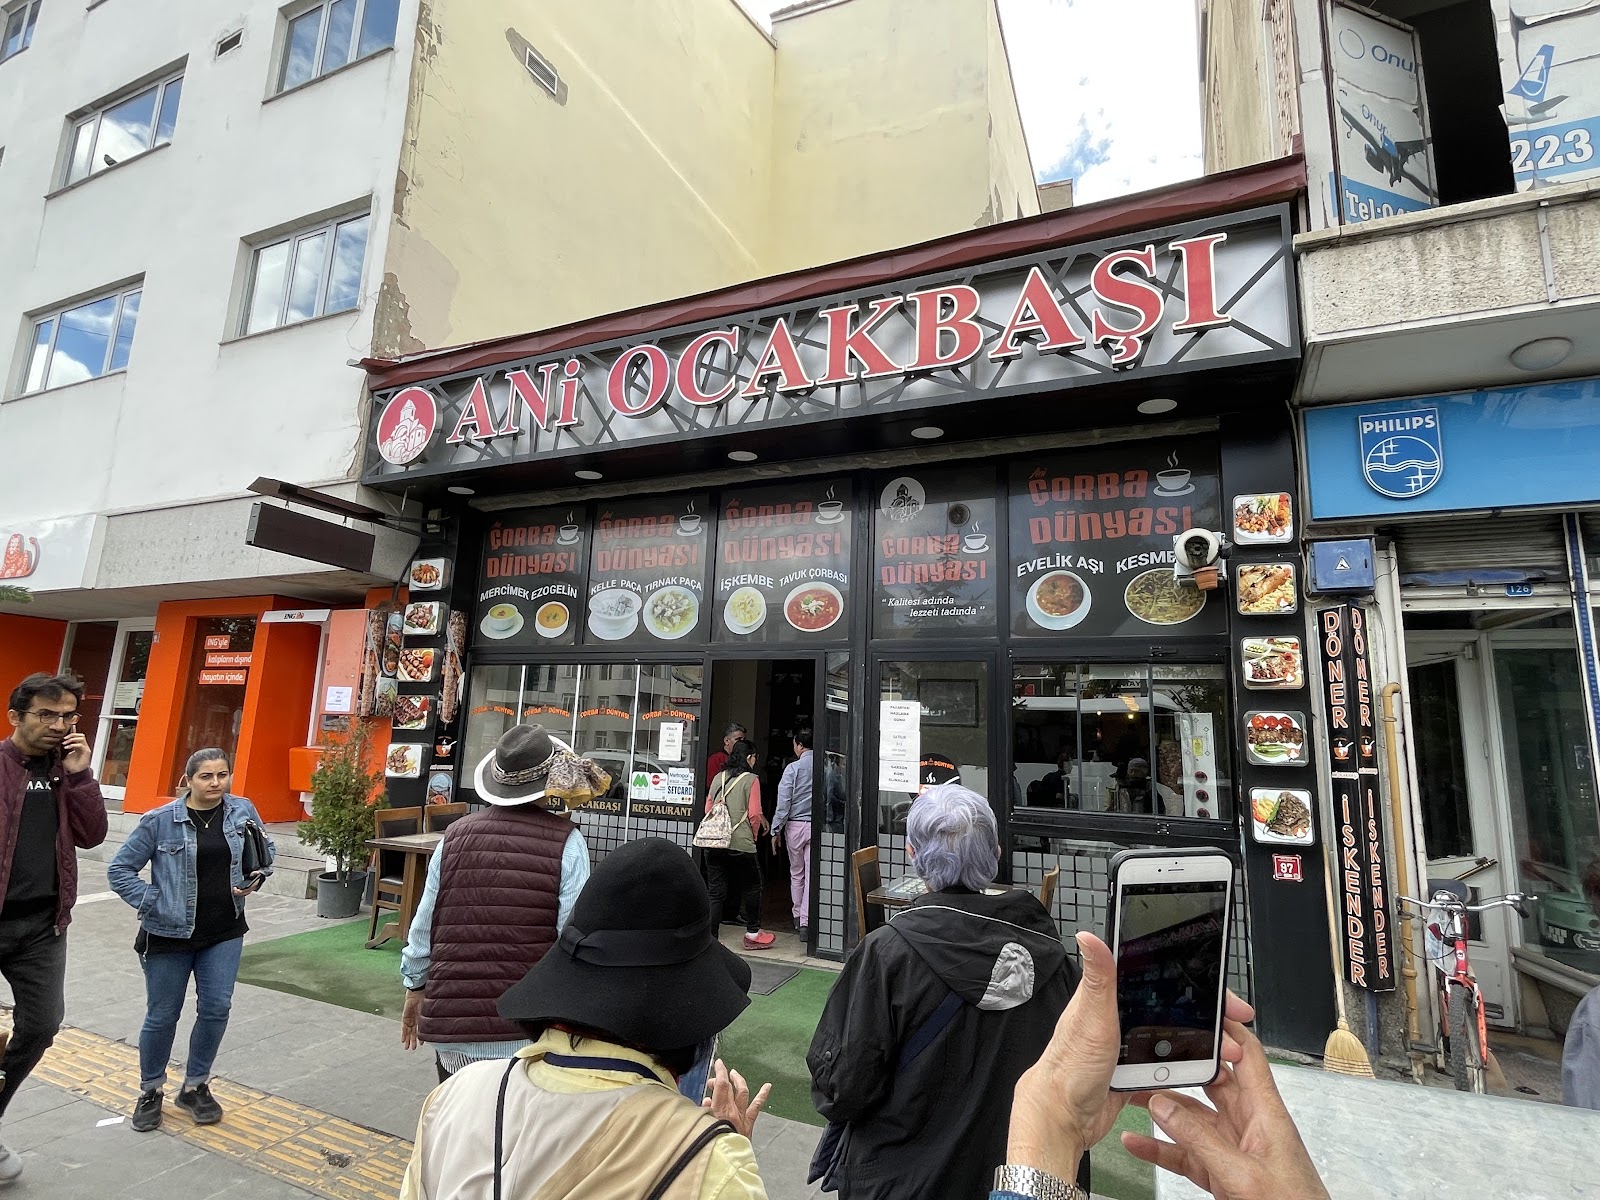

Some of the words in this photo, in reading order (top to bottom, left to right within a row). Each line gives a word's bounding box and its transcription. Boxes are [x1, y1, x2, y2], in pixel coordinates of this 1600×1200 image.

[1509, 128, 1595, 174] 223
[606, 232, 1233, 419] OCAKBAŞI
[1362, 413, 1437, 434] PHILIPS
[1016, 552, 1074, 578] EVELİK
[1076, 556, 1104, 575] AŞI
[644, 576, 678, 593] TIRNAK
[679, 576, 702, 591] PAÇA
[720, 573, 774, 591] İŞKEMBE
[779, 568, 807, 587] TAVUK
[808, 568, 848, 584] ÇORBASI
[480, 583, 530, 602] MERCİMEK
[530, 584, 578, 601] EZOGELİN
[590, 579, 617, 595] KELLE
[620, 579, 642, 593] PAÇA
[1509, 584, 1529, 594] 126
[922, 595, 955, 606] adında
[909, 607, 939, 617] lezzeti
[1323, 611, 1349, 729] DÖNER
[1351, 607, 1372, 727] DÖNER
[667, 785, 693, 796] SETCARD
[631, 803, 694, 817] RESTAURANT
[1280, 862, 1294, 874] 97
